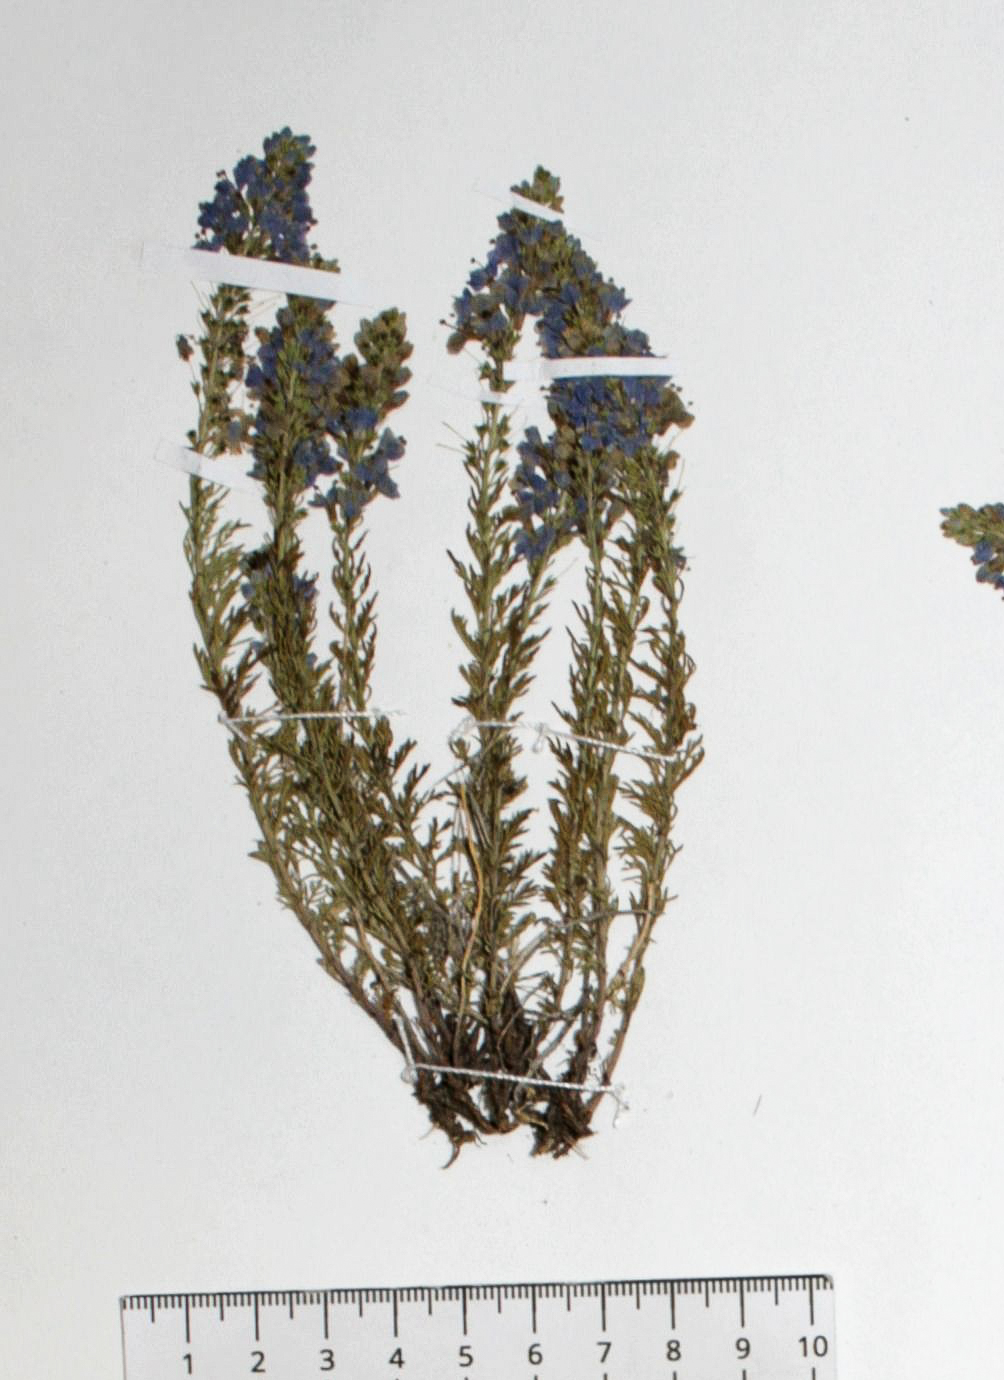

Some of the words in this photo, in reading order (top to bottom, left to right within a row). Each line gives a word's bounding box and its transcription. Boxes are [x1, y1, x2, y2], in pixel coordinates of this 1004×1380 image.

[182, 1354, 193, 1375] 1
[250, 1350, 266, 1373] 2
[320, 1349, 336, 1371] 3
[388, 1347, 406, 1369] 4
[458, 1345, 474, 1368] 5
[527, 1342, 543, 1366] 6
[596, 1341, 612, 1364] 7
[666, 1339, 682, 1362] 8
[735, 1337, 751, 1360] 9
[798, 1335, 828, 1358] 10
